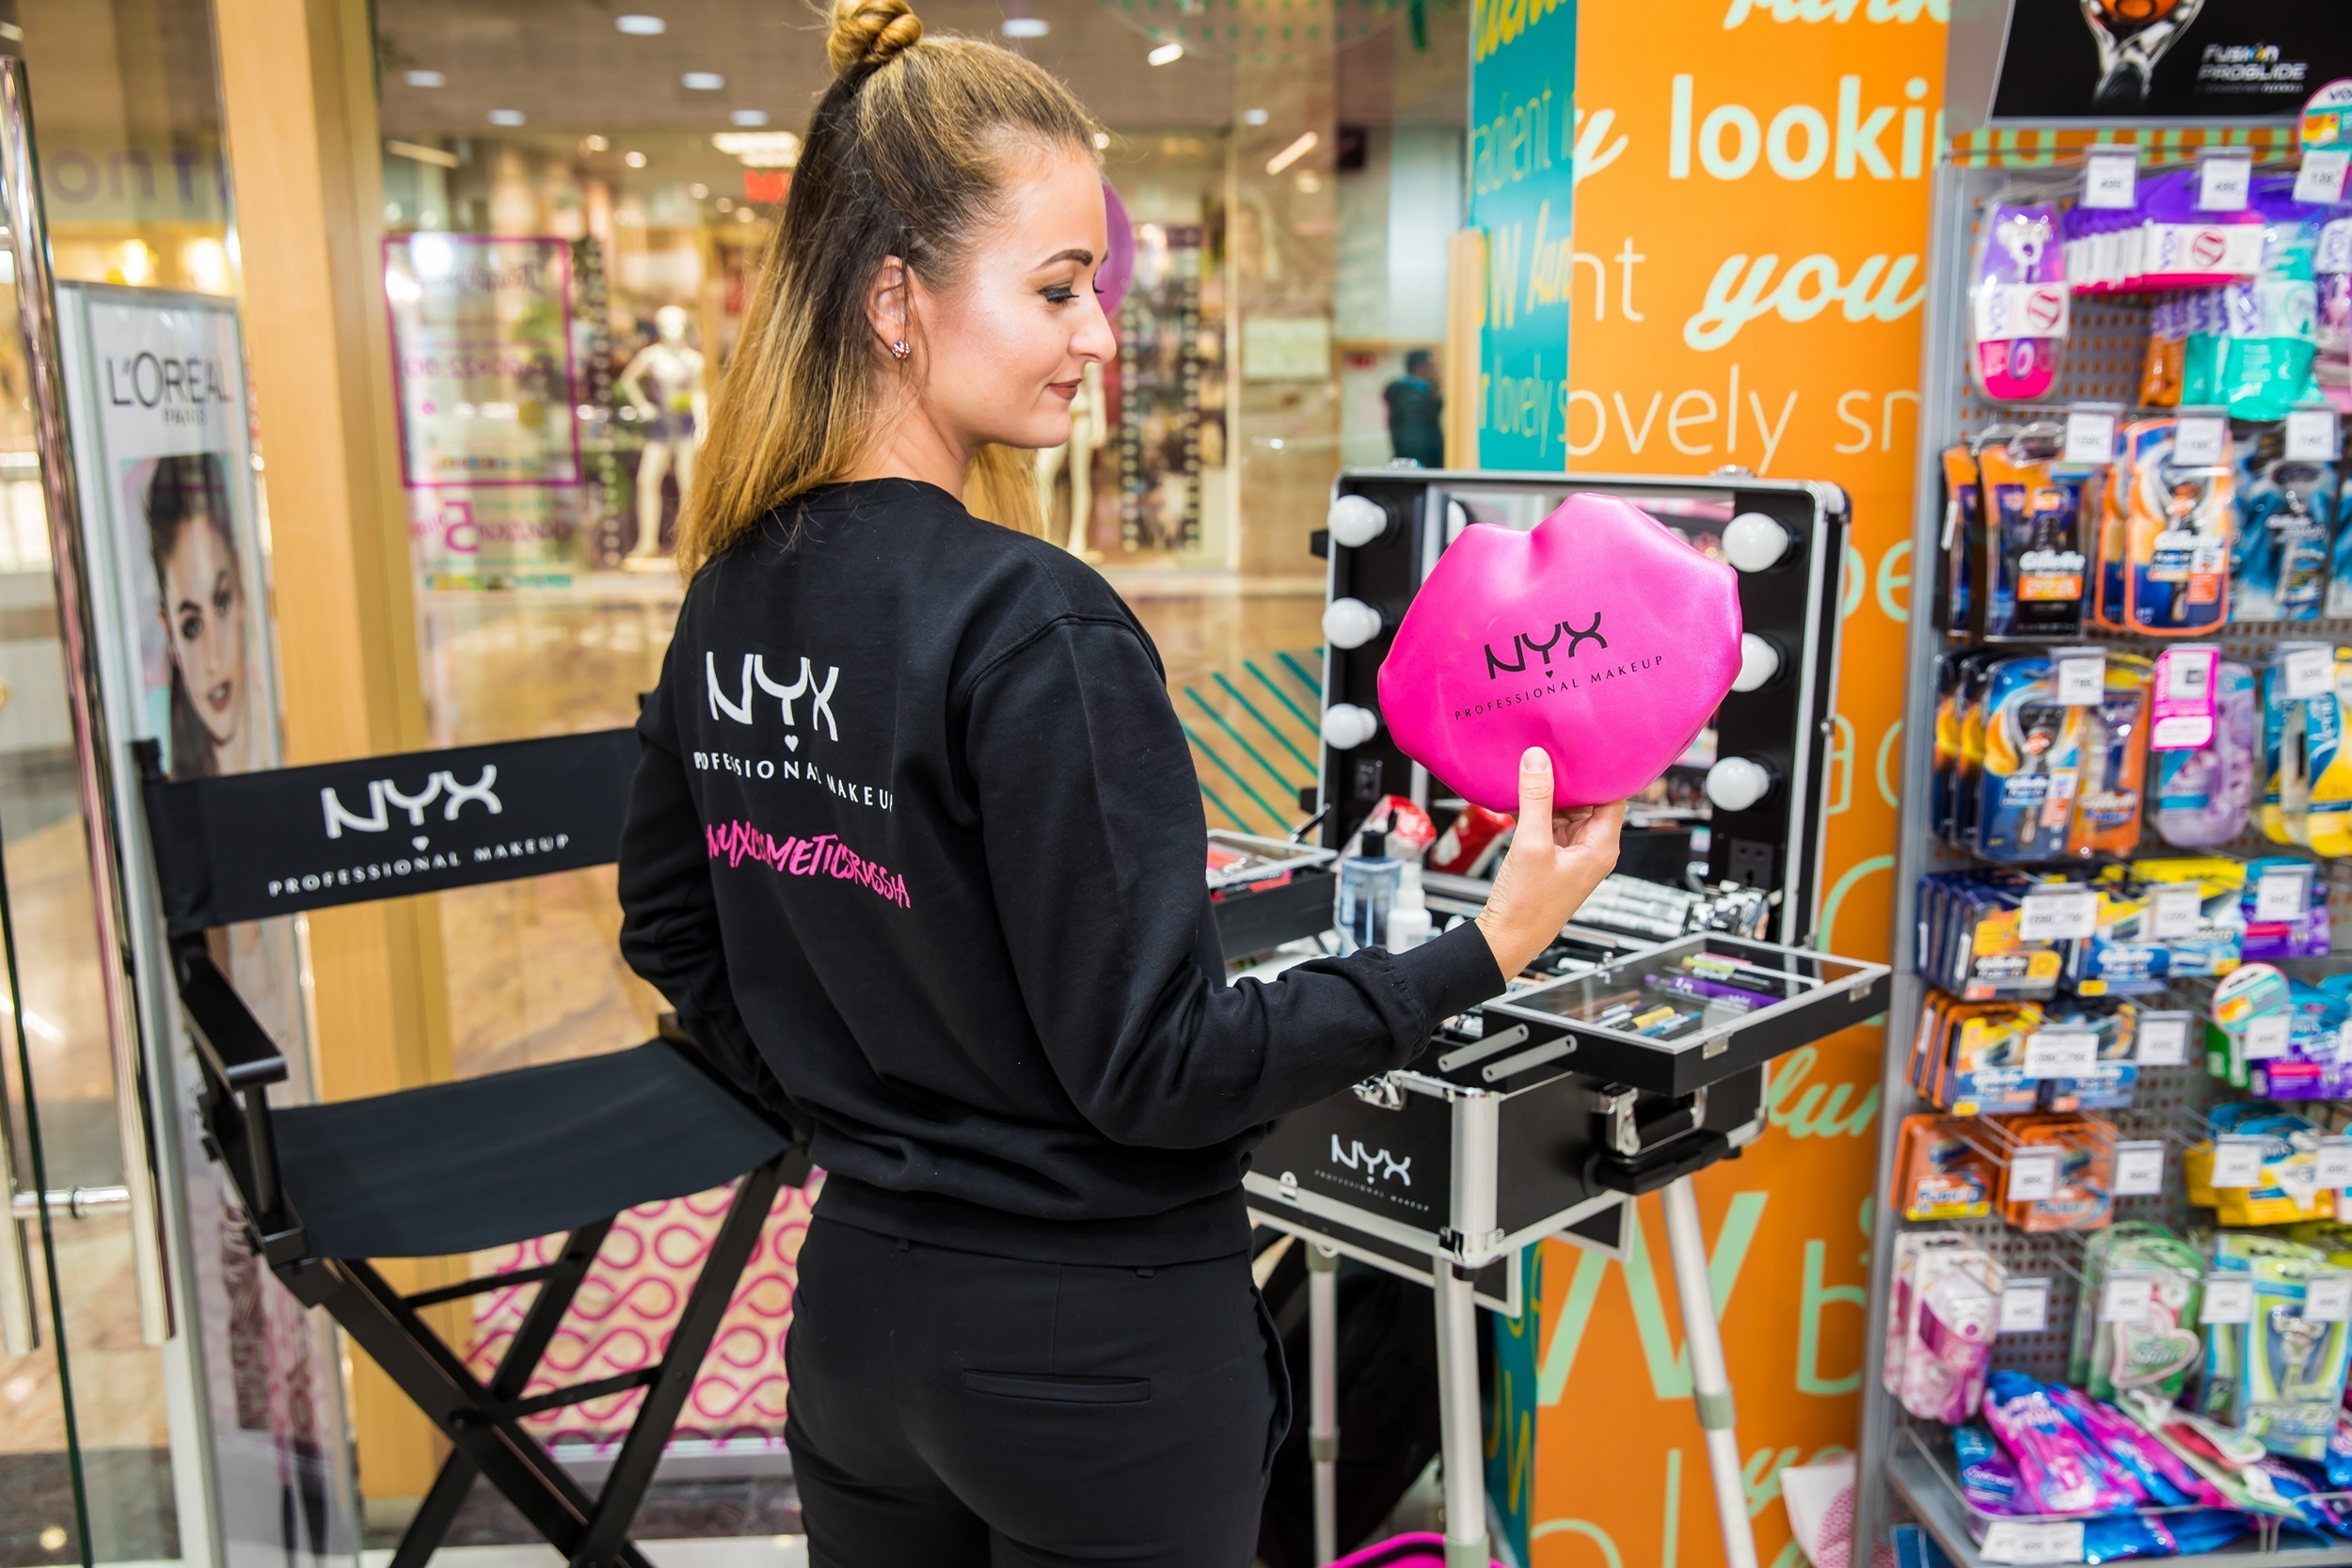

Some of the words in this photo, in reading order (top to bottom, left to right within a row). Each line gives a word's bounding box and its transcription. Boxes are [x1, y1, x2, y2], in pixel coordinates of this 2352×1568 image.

[1485, 611, 1608, 680] NYX
[707, 651, 839, 741] NYX
[1454, 678, 1579, 721] PROFESSIONAL
[1591, 655, 1663, 684] MAKEUP
[320, 764, 503, 839] NYX
[268, 850, 461, 897] PROFESSIONAL
[473, 833, 569, 863] MAKEUP
[1331, 1133, 1411, 1187] NYX
